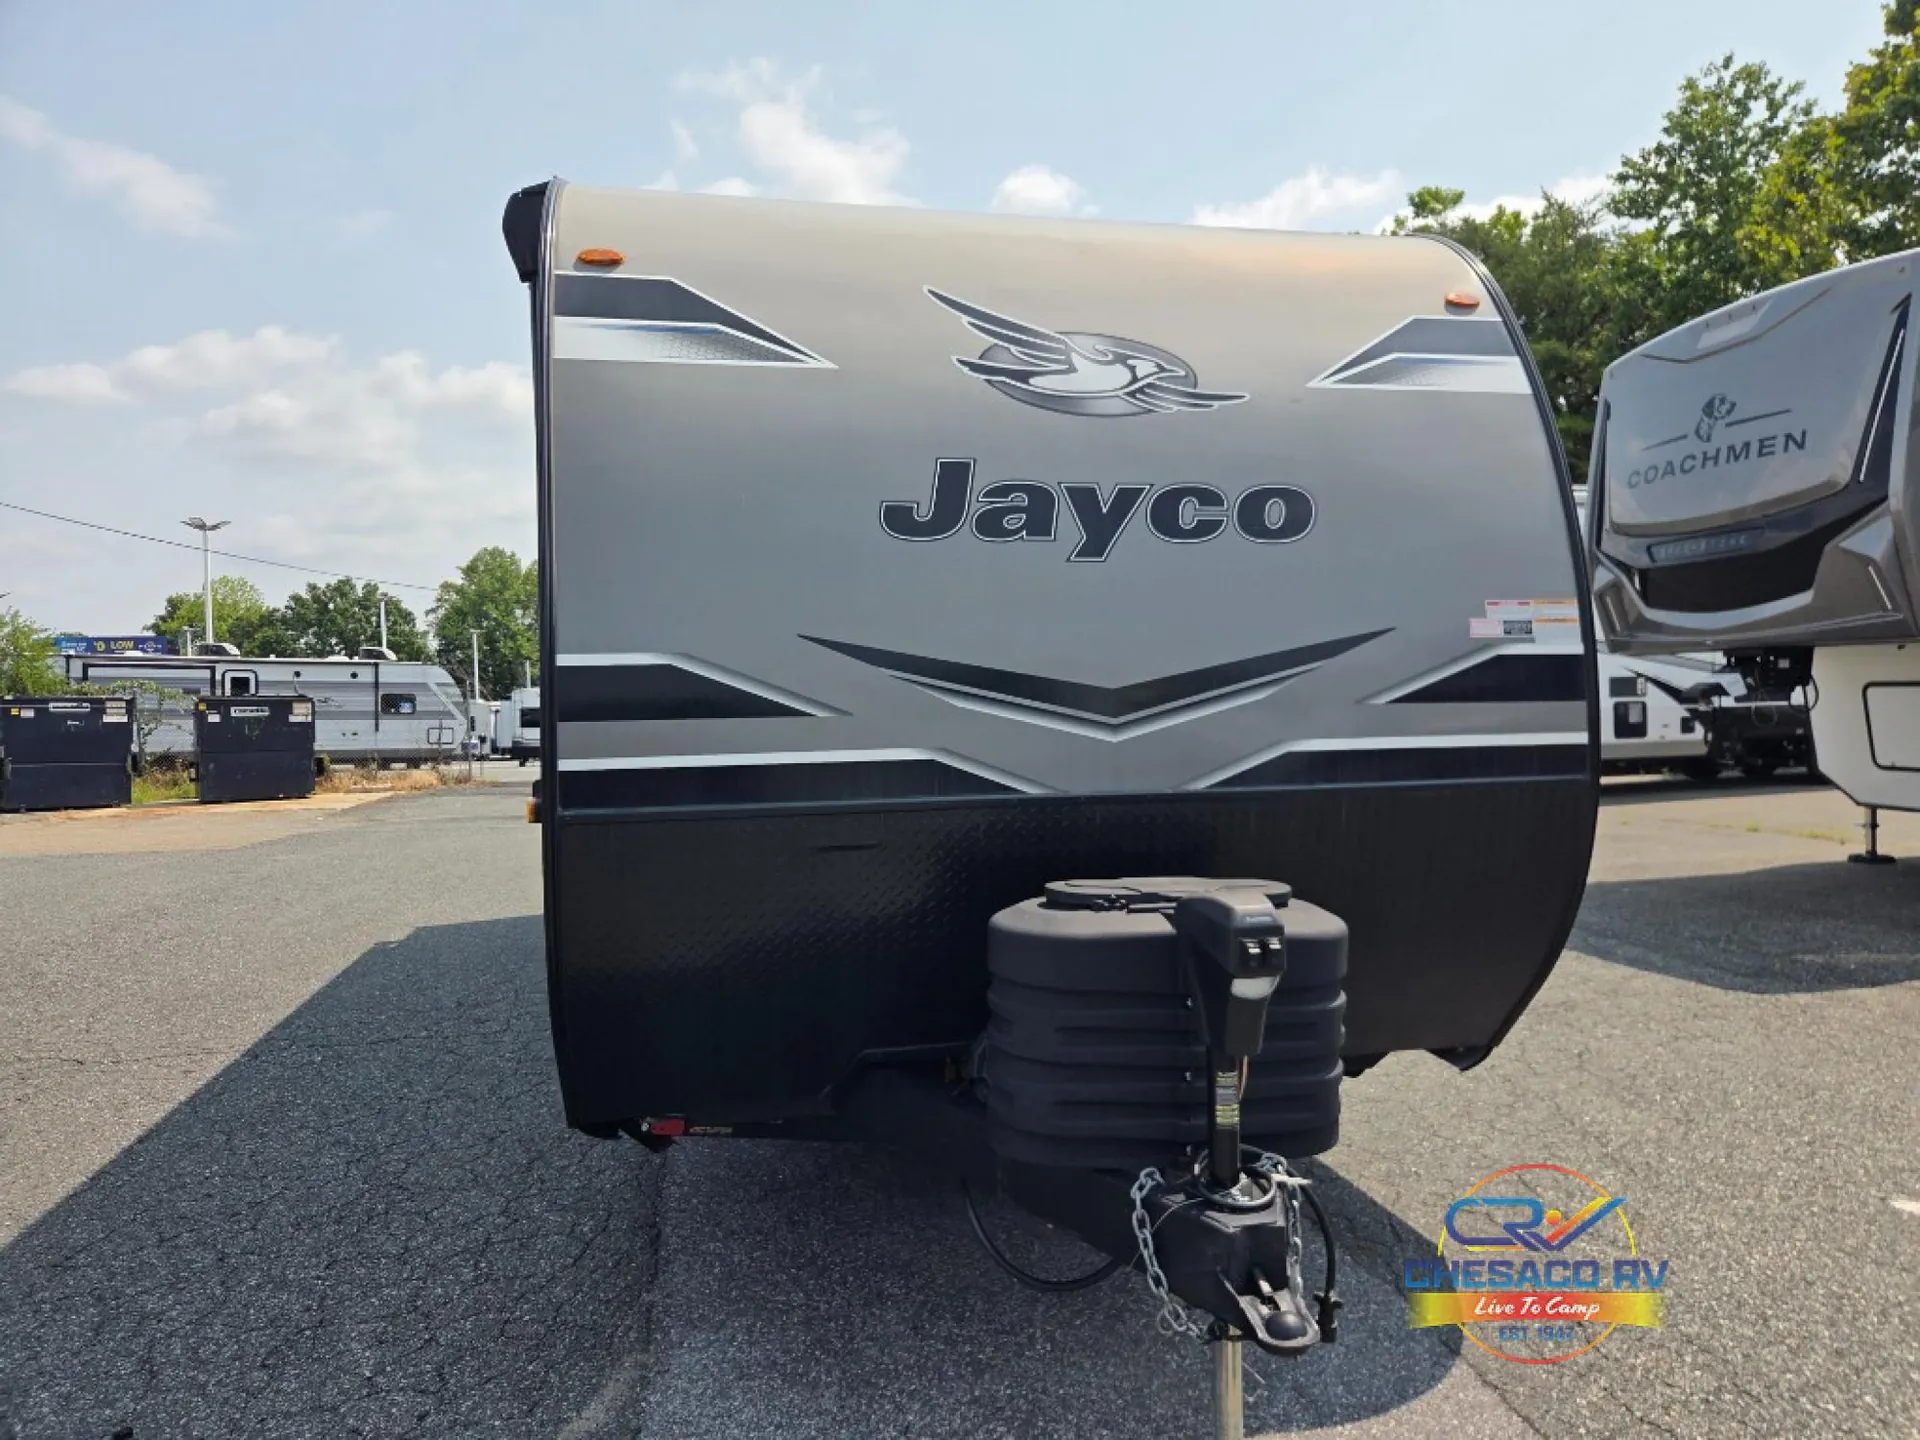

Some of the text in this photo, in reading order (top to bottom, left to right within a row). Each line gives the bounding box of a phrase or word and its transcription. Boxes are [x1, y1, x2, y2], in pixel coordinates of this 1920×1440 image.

[1627, 429, 1808, 489] COACHMEN
[879, 457, 1317, 563] Jayco
[110, 640, 135, 650] LOW
